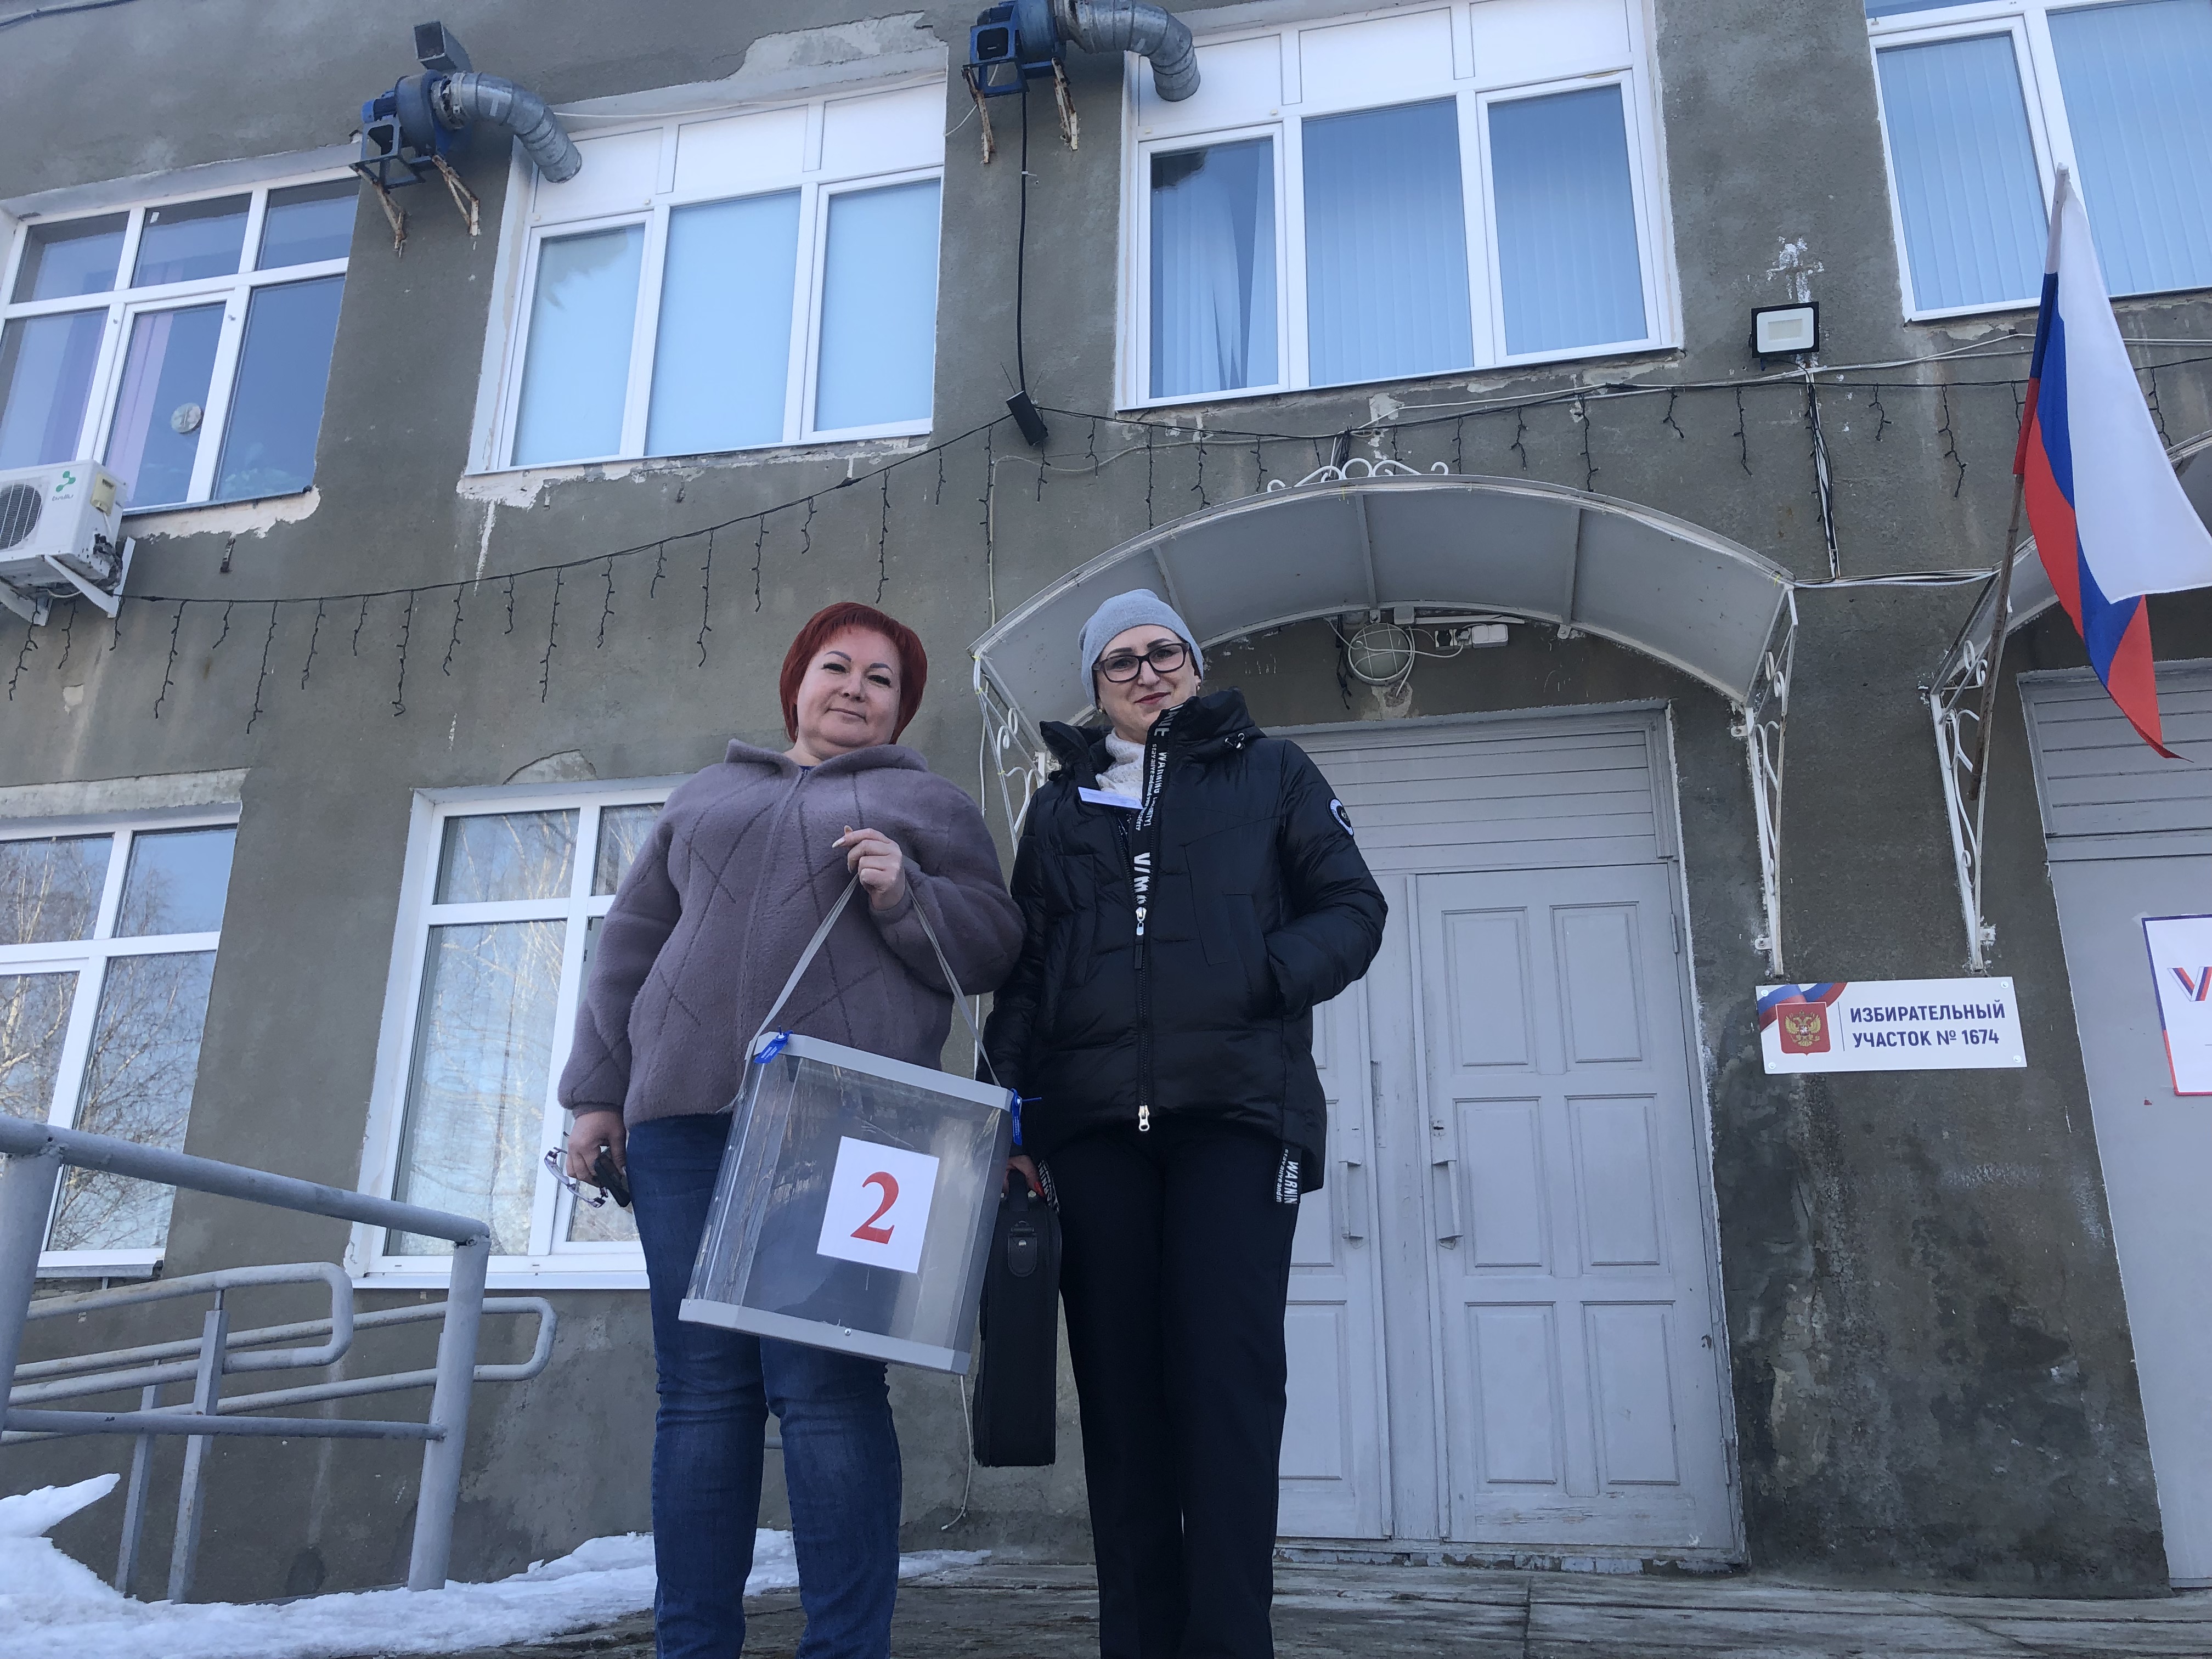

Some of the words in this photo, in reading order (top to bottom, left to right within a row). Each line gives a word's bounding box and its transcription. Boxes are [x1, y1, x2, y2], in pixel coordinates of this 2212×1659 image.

[1850, 999, 2006, 1023] ИЗБИРАТЕЛЬНЫЙ
[1852, 1030, 1932, 1048] УЧАСТОК
[1937, 1030, 1957, 1046] №
[1961, 1029, 2000, 1045] 1674
[850, 1171, 899, 1244] 2
